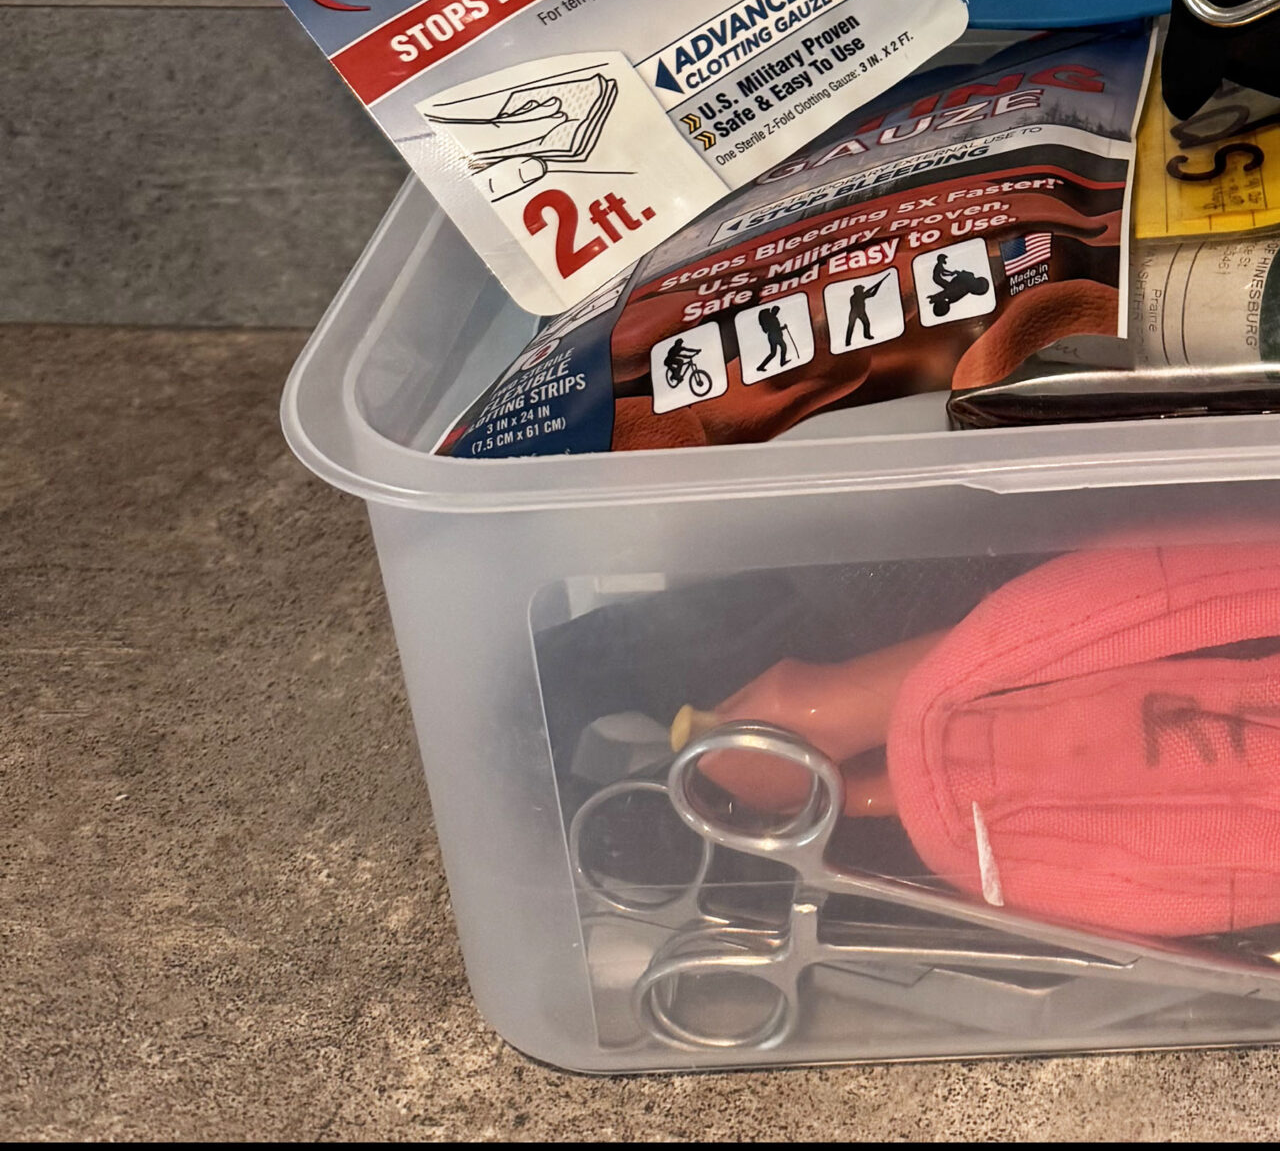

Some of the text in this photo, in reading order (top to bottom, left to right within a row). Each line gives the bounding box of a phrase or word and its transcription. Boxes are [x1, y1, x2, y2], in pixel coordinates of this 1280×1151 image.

[537, 3, 563, 26] For
[685, 21, 774, 90] CLOTTING
[697, 13, 860, 123] U.S. Military Proven
[713, 36, 866, 141] Safe & Easy To Use
[714, 31, 915, 167] One Sterile Z-Fold Clotting Gauze: 3 IN. X 2 FT.
[755, 88, 1046, 186] GAUZE
[891, 140, 981, 169] EXTERNAL
[982, 130, 1015, 145] USE
[1020, 125, 1043, 136] TO
[1165, 141, 1266, 182] S
[746, 145, 990, 229] STOP BLEEDING
[657, 253, 748, 292] Stops
[754, 207, 889, 262] Bleeding
[896, 194, 940, 215] 5X
[681, 213, 1018, 323] Safe and Easy to Use.
[696, 199, 1011, 297] U.S. Military Proven,
[1008, 262, 1049, 287] Made in
[1009, 272, 1050, 297] the USA
[1245, 256, 1273, 348] HINESBURG
[479, 357, 572, 418] FLEXIBLE
[519, 347, 575, 383] STERILE
[468, 372, 587, 433] LOTTING STRIPS
[486, 404, 551, 435] 3 IN x 24 IN
[471, 416, 567, 455] (7.5 CM x 61 CM)
